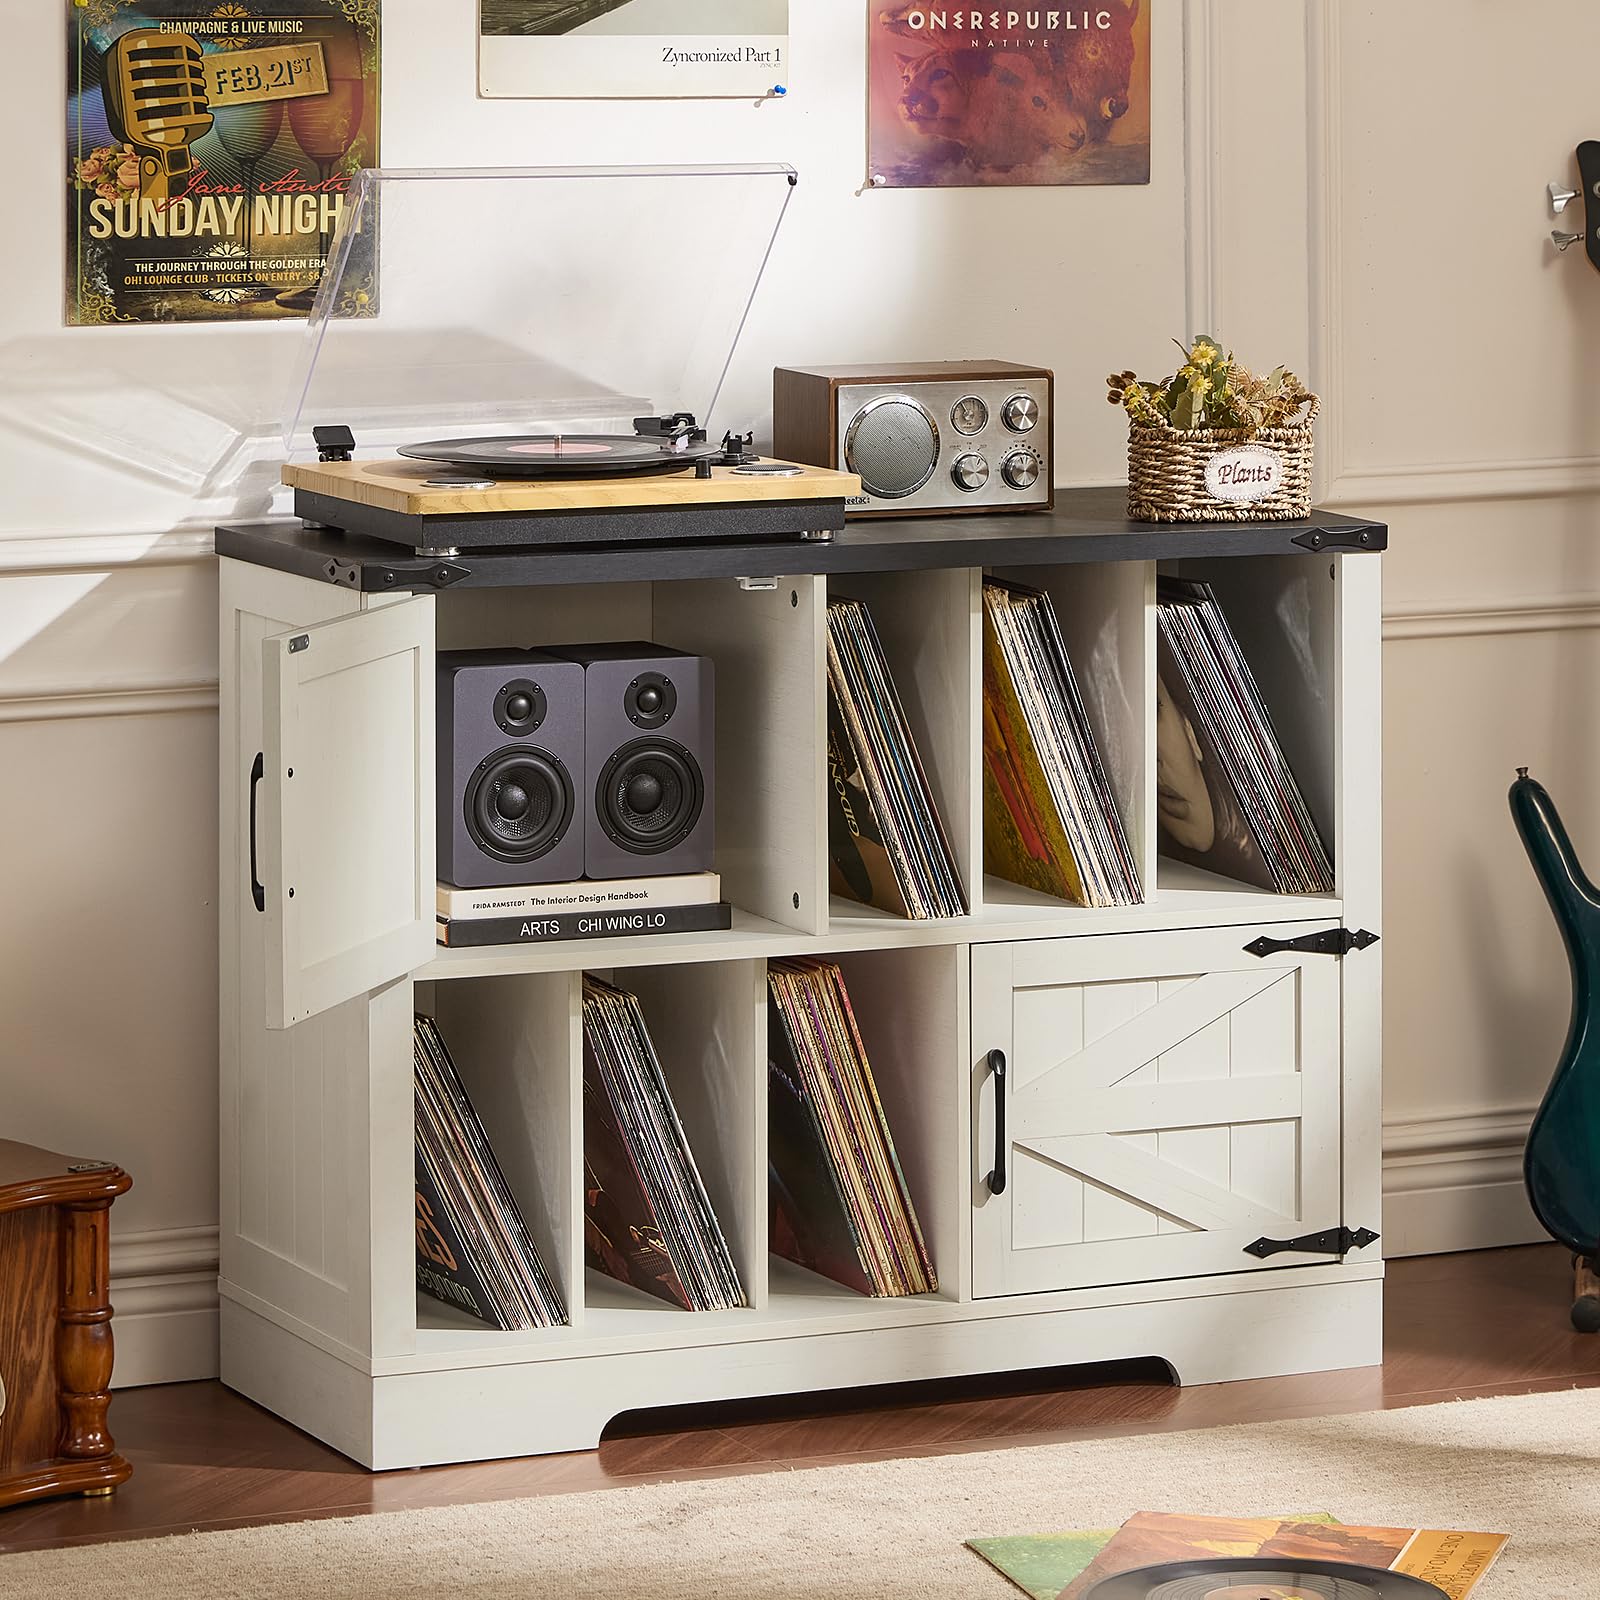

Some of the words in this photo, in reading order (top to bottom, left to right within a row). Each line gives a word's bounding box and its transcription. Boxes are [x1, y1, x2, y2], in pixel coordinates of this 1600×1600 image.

[160, 21, 229, 34] CHAMPAGNE
[231, 21, 239, 33] &
[242, 21, 266, 33] LIVE
[268, 20, 303, 33] MUSIC
[907, 11, 1112, 30] ONEREPUBLIC
[971, 39, 1049, 48] NATIVE
[662, 47, 742, 67] Zyncronized
[745, 47, 771, 62] Part
[774, 48, 781, 62] 1
[88, 196, 244, 239] SUNDAY
[135, 263, 154, 273] THE
[155, 261, 199, 273] JOURNEY
[200, 260, 247, 272] THROUGH
[249, 260, 268, 271] THE
[269, 259, 306, 270] GOLDEN
[308, 258, 326, 269] ERA
[124, 275, 142, 286] OH!
[144, 274, 183, 285] LOUNGE
[184, 274, 209, 284] CLUB
[216, 273, 253, 283] TICKETS
[255, 272, 271, 282] ON
[271, 272, 301, 282] ENTRY
[1218, 460, 1272, 484] Plants
[472, 902, 491, 910] FRIDA
[492, 900, 526, 909] RAMSTEDT
[530, 897, 546, 906] The
[547, 896, 577, 905] Interior
[578, 894, 605, 905] Design
[607, 890, 649, 902] Handbook
[520, 920, 560, 936] ARTS
[578, 918, 602, 933] CHI
[605, 915, 644, 931] WING
[647, 913, 666, 928] LO
